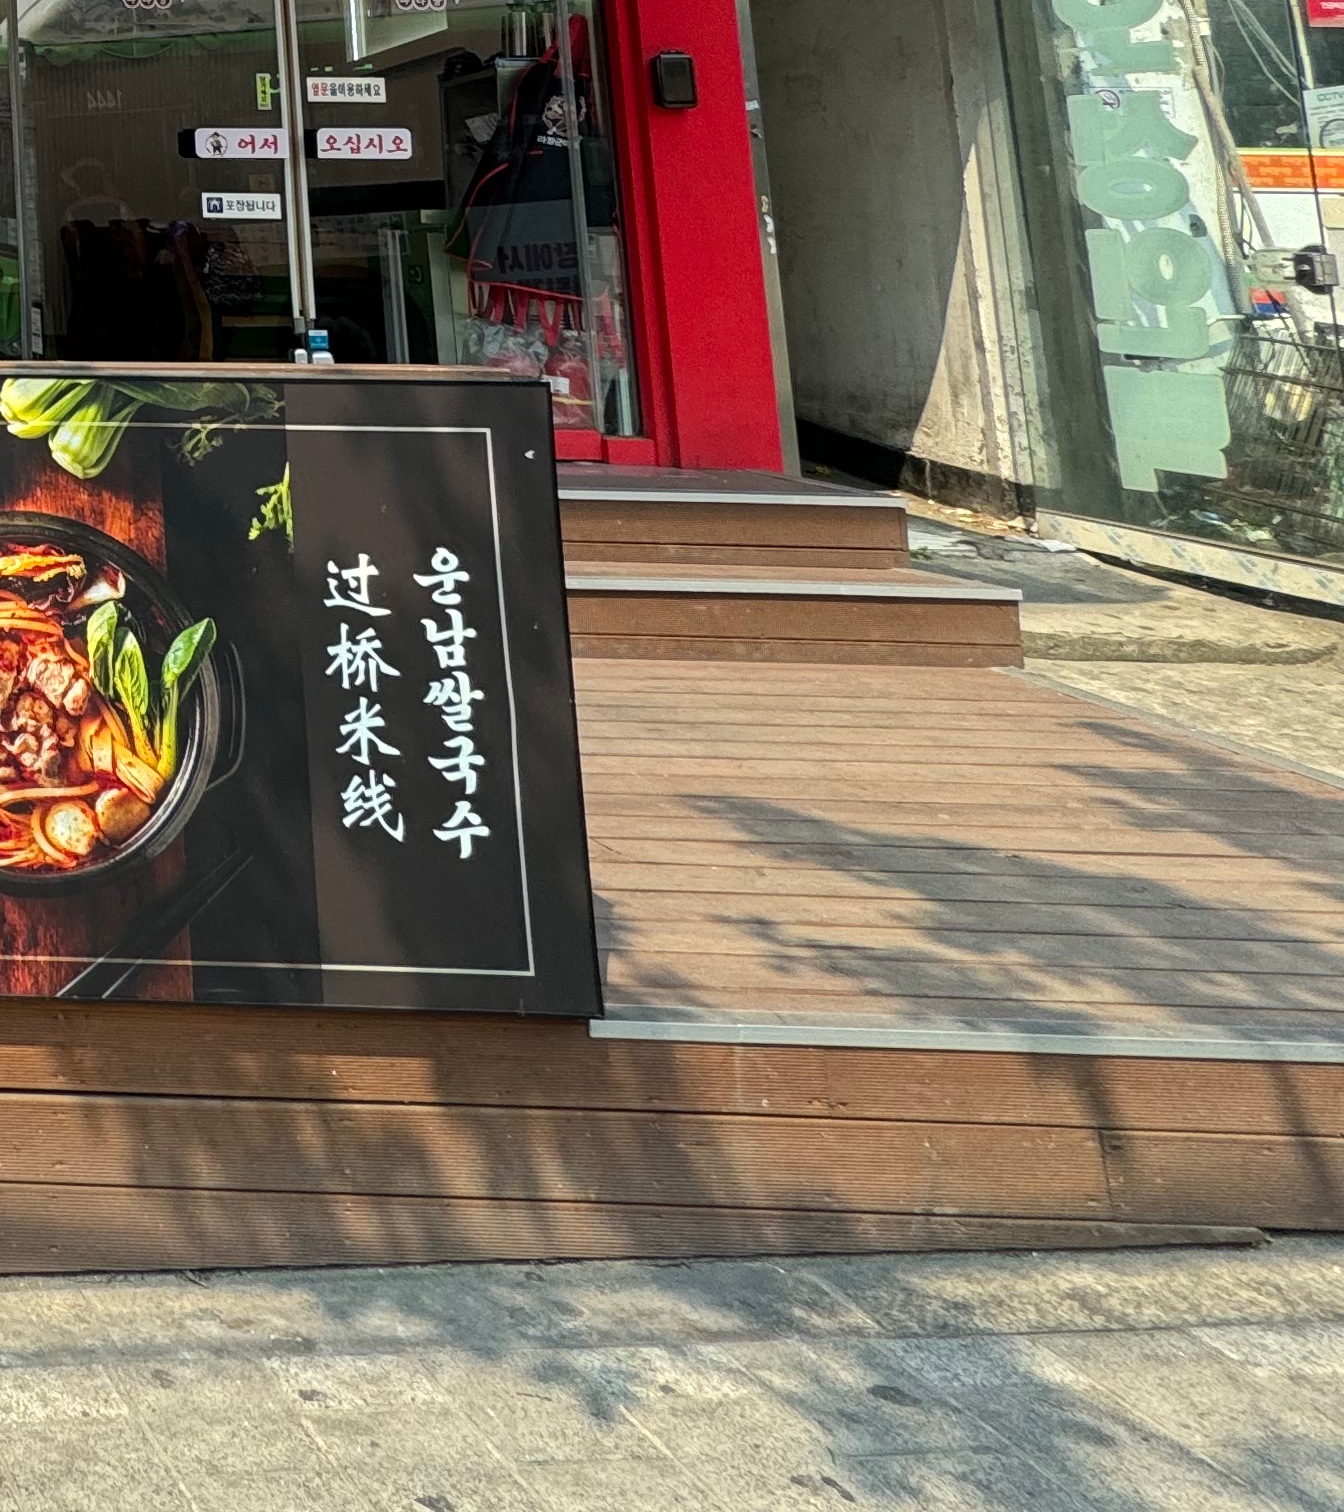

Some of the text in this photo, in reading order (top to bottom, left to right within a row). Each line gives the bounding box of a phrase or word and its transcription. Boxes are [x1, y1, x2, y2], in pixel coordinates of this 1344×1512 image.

[237, 134, 409, 155] 어서 오십시오
[322, 552, 406, 844] 过桥米线
[412, 545, 492, 860] 운남쌀국수
